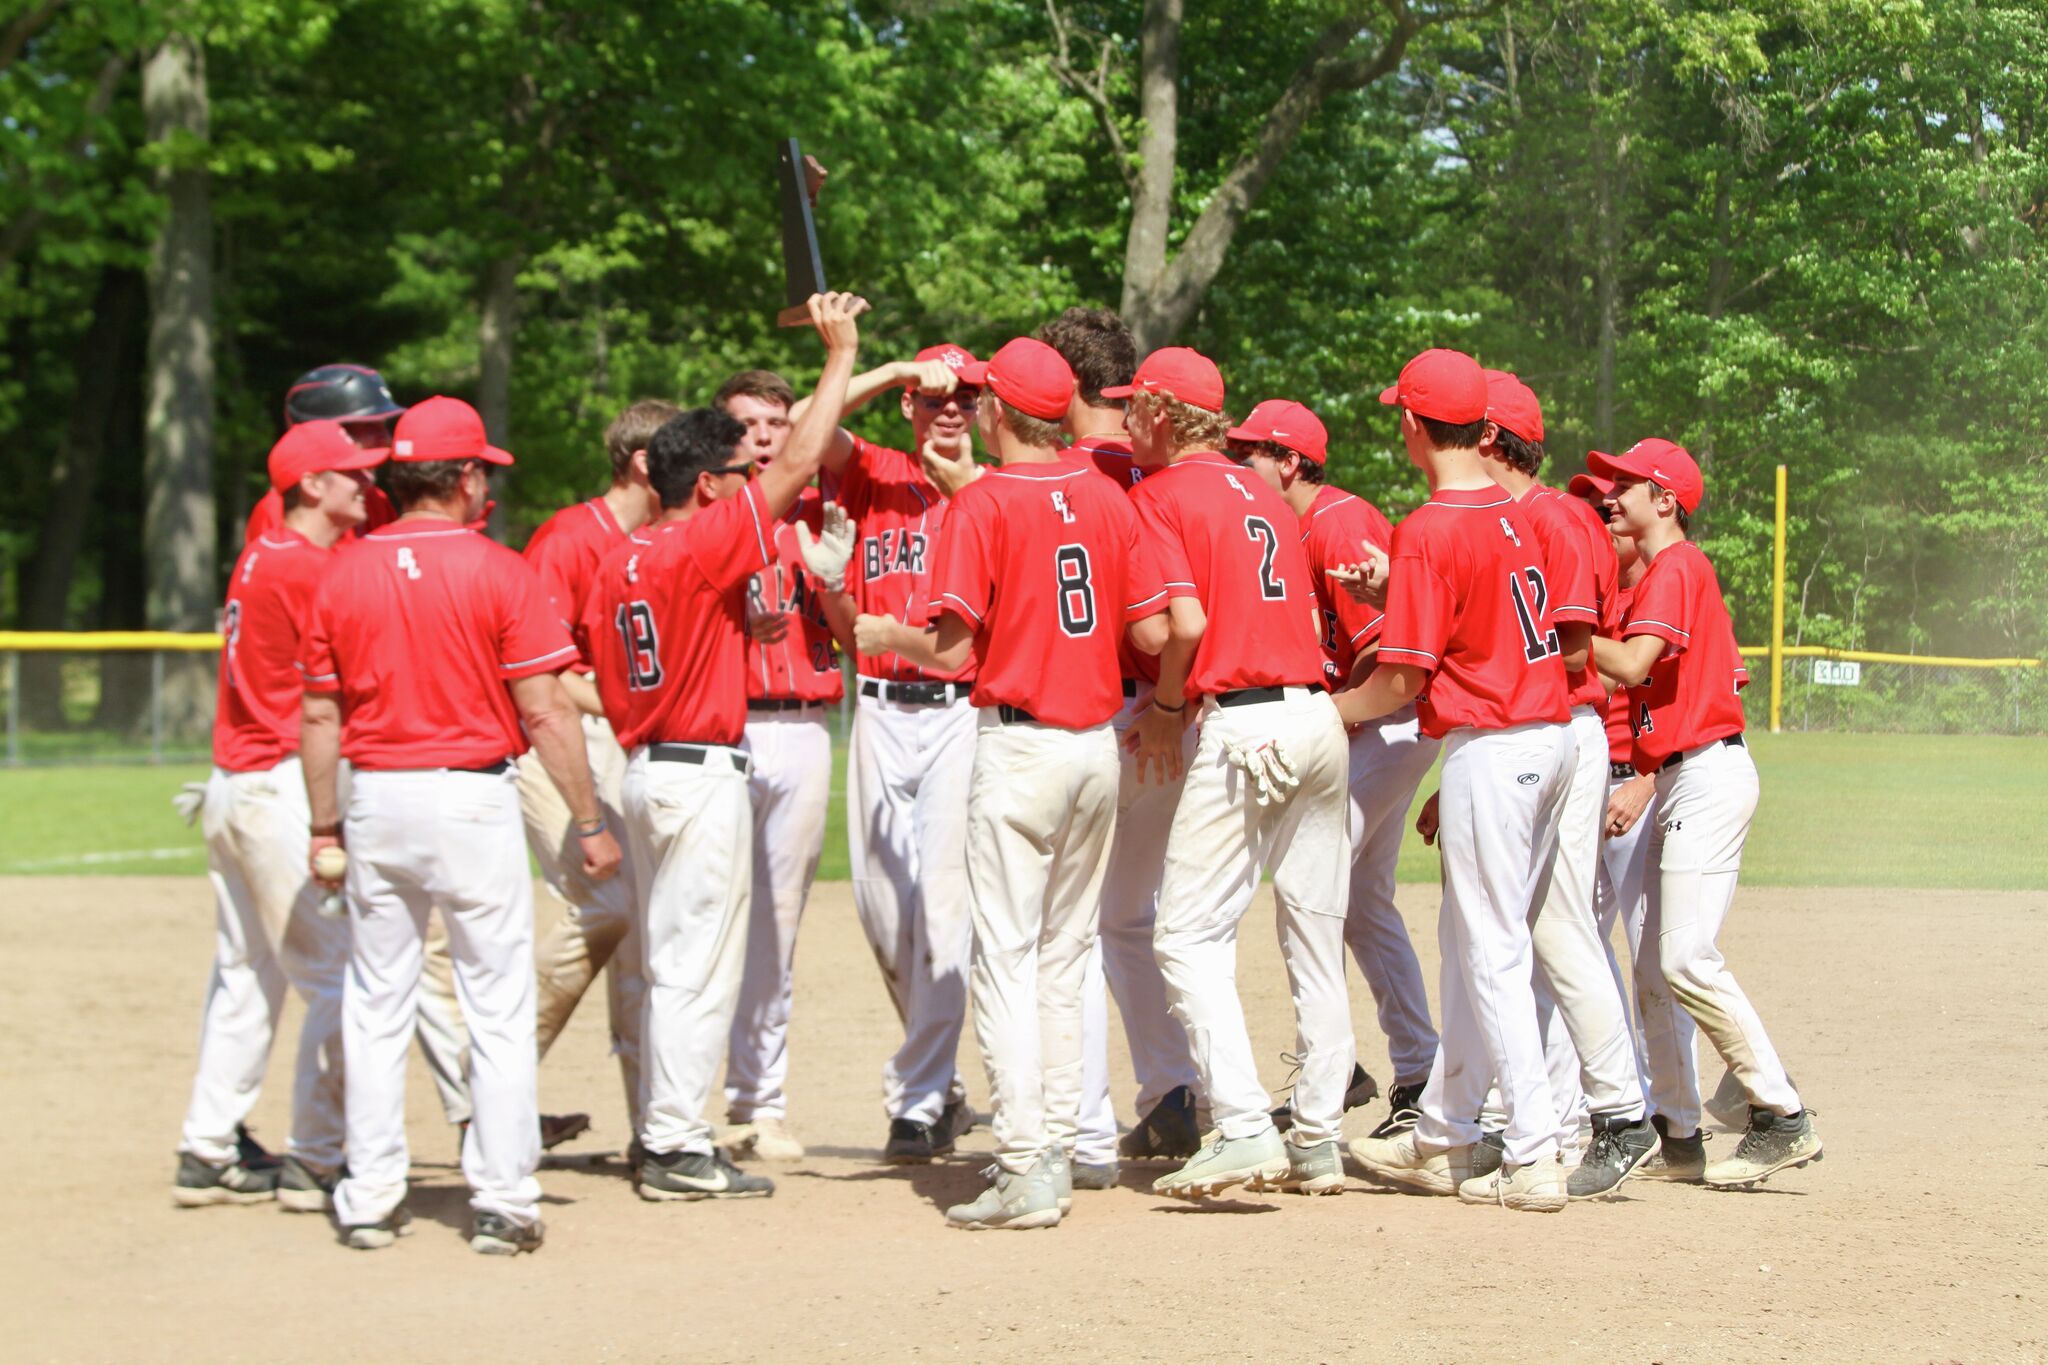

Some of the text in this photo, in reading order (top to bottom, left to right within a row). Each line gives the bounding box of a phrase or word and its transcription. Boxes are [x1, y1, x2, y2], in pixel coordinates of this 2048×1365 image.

[1051, 490, 1076, 524] BL
[863, 527, 928, 584] BEAR
[1055, 543, 1097, 638] 8
[1244, 515, 1286, 601] 2
[1510, 565, 1561, 664] 12
